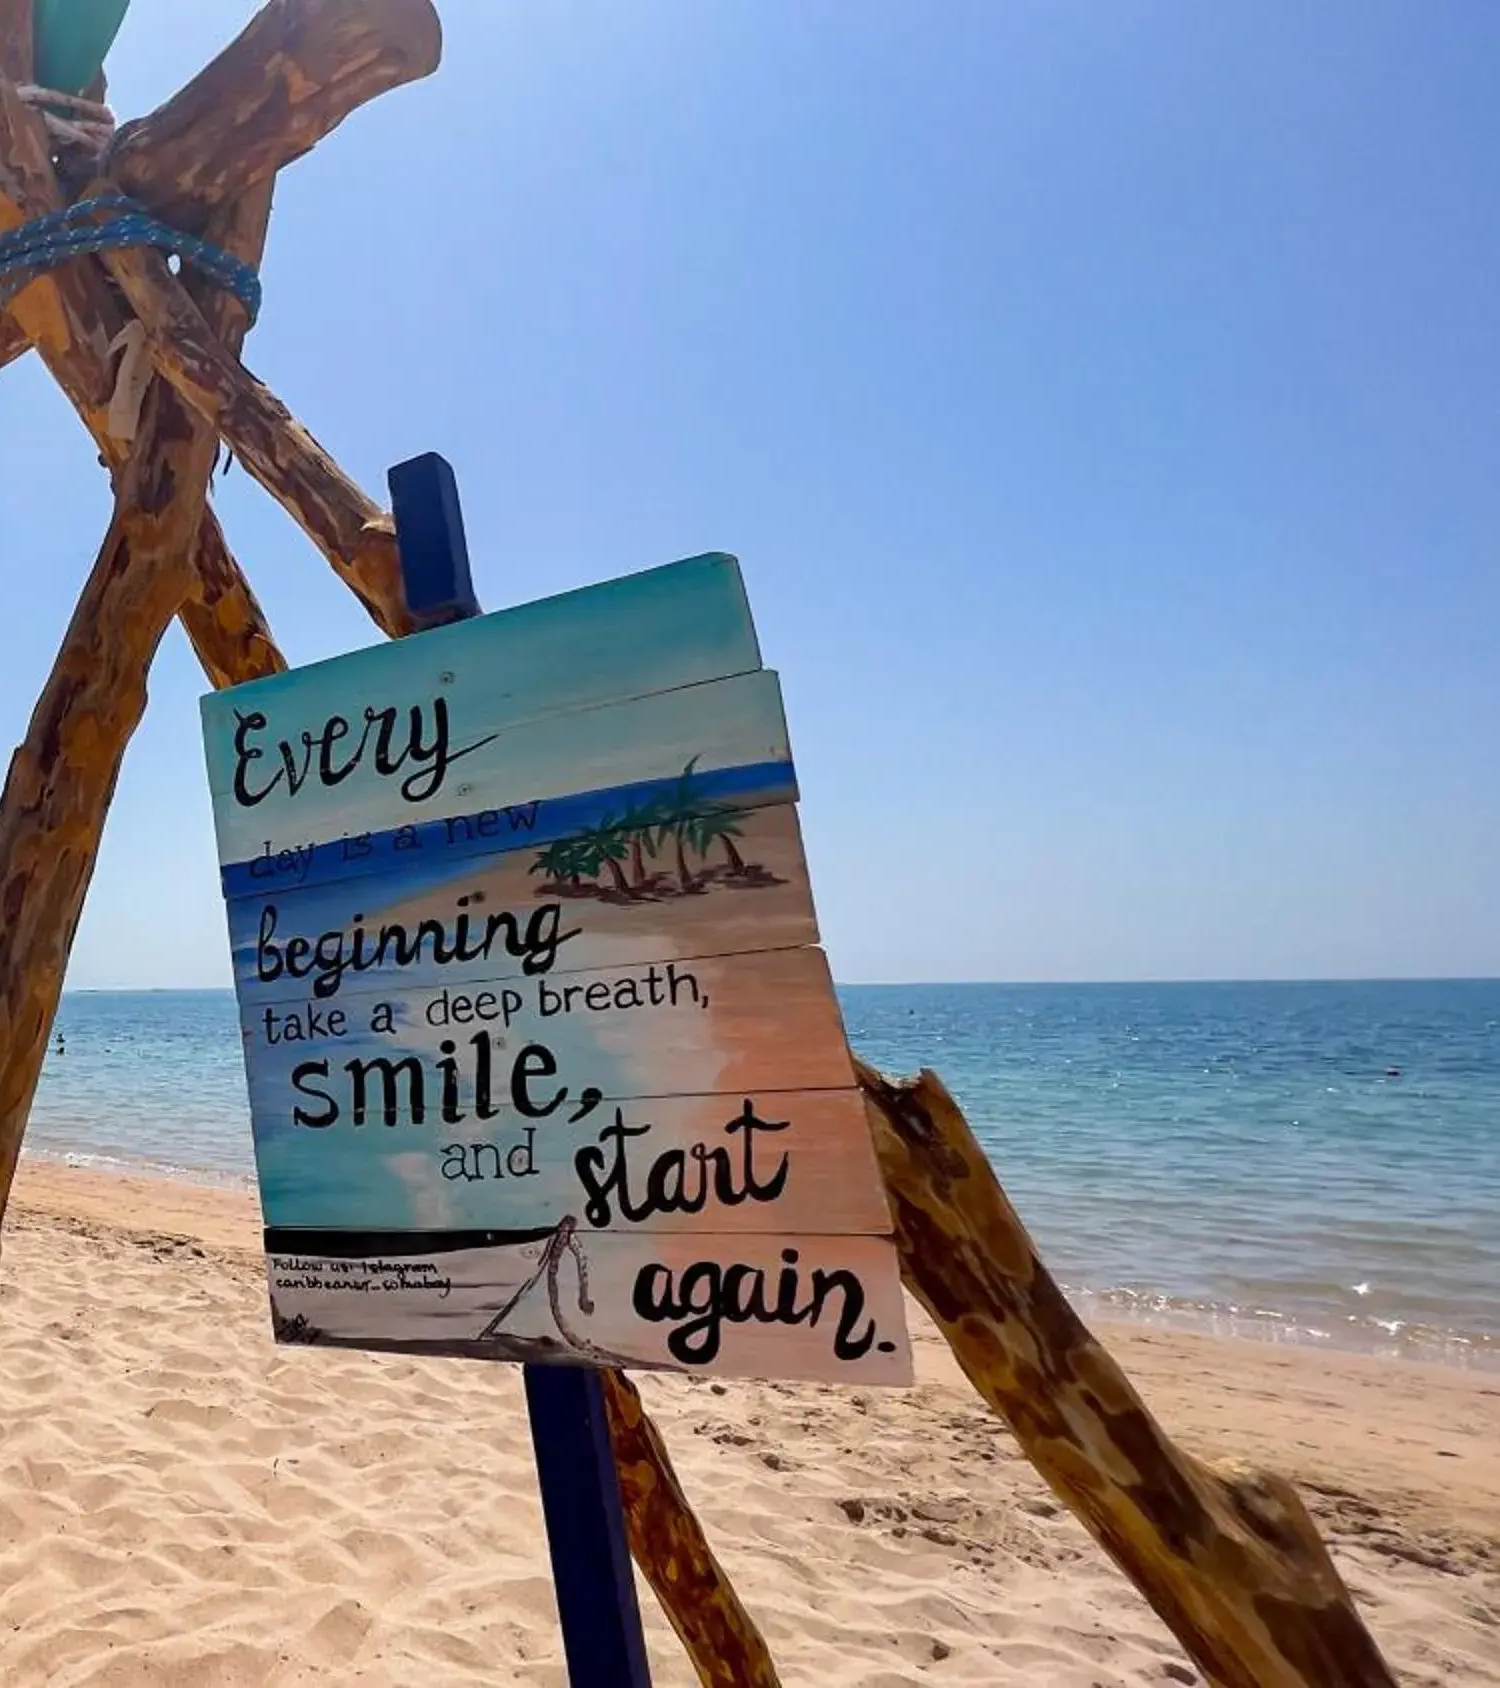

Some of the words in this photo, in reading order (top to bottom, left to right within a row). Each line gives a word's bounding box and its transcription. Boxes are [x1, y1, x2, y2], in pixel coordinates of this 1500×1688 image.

[233, 696, 499, 807] Every
[249, 840, 315, 883] day
[342, 832, 373, 861] is
[393, 824, 423, 850] a
[445, 800, 541, 844] new
[257, 890, 583, 997] beginning
[264, 1005, 348, 1046] take
[370, 1002, 396, 1035] a
[426, 989, 524, 1029] deep
[538, 964, 710, 1019] breath,
[291, 1030, 604, 1129] smile,
[440, 1128, 541, 1183] and
[574, 1098, 791, 1229] start
[272, 1257, 324, 1272] Follow
[631, 1248, 897, 1364] again.
